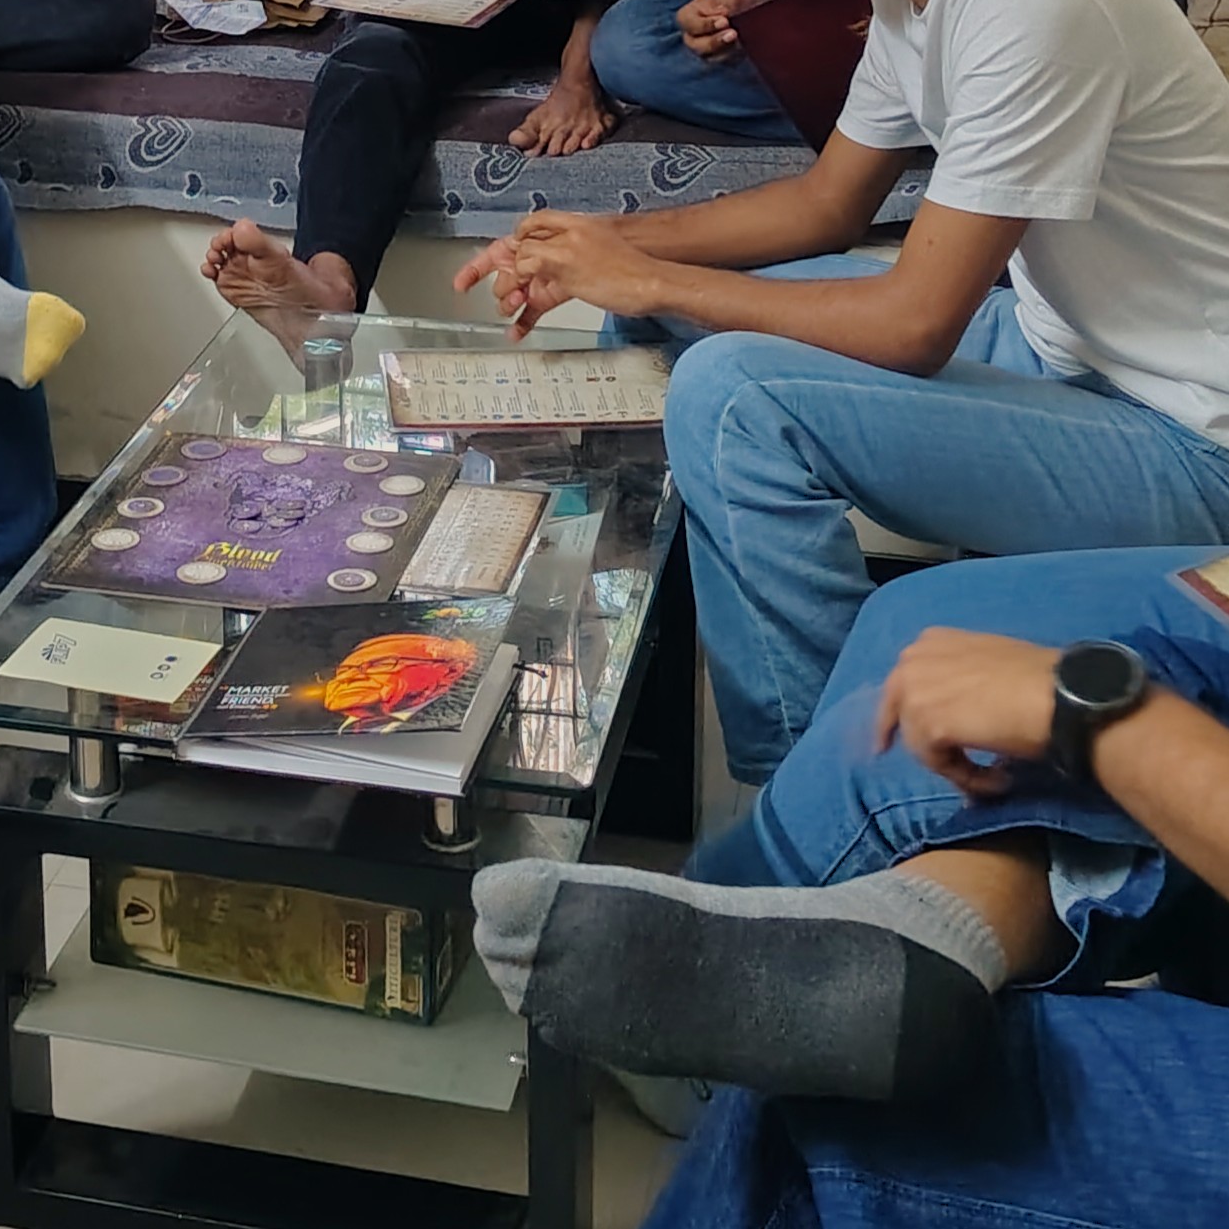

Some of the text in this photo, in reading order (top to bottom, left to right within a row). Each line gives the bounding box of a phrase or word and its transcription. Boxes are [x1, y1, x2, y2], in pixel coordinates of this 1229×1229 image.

[195, 540, 283, 562] Blood
[227, 684, 290, 694] MARKET
[220, 696, 275, 705] FRIEND
